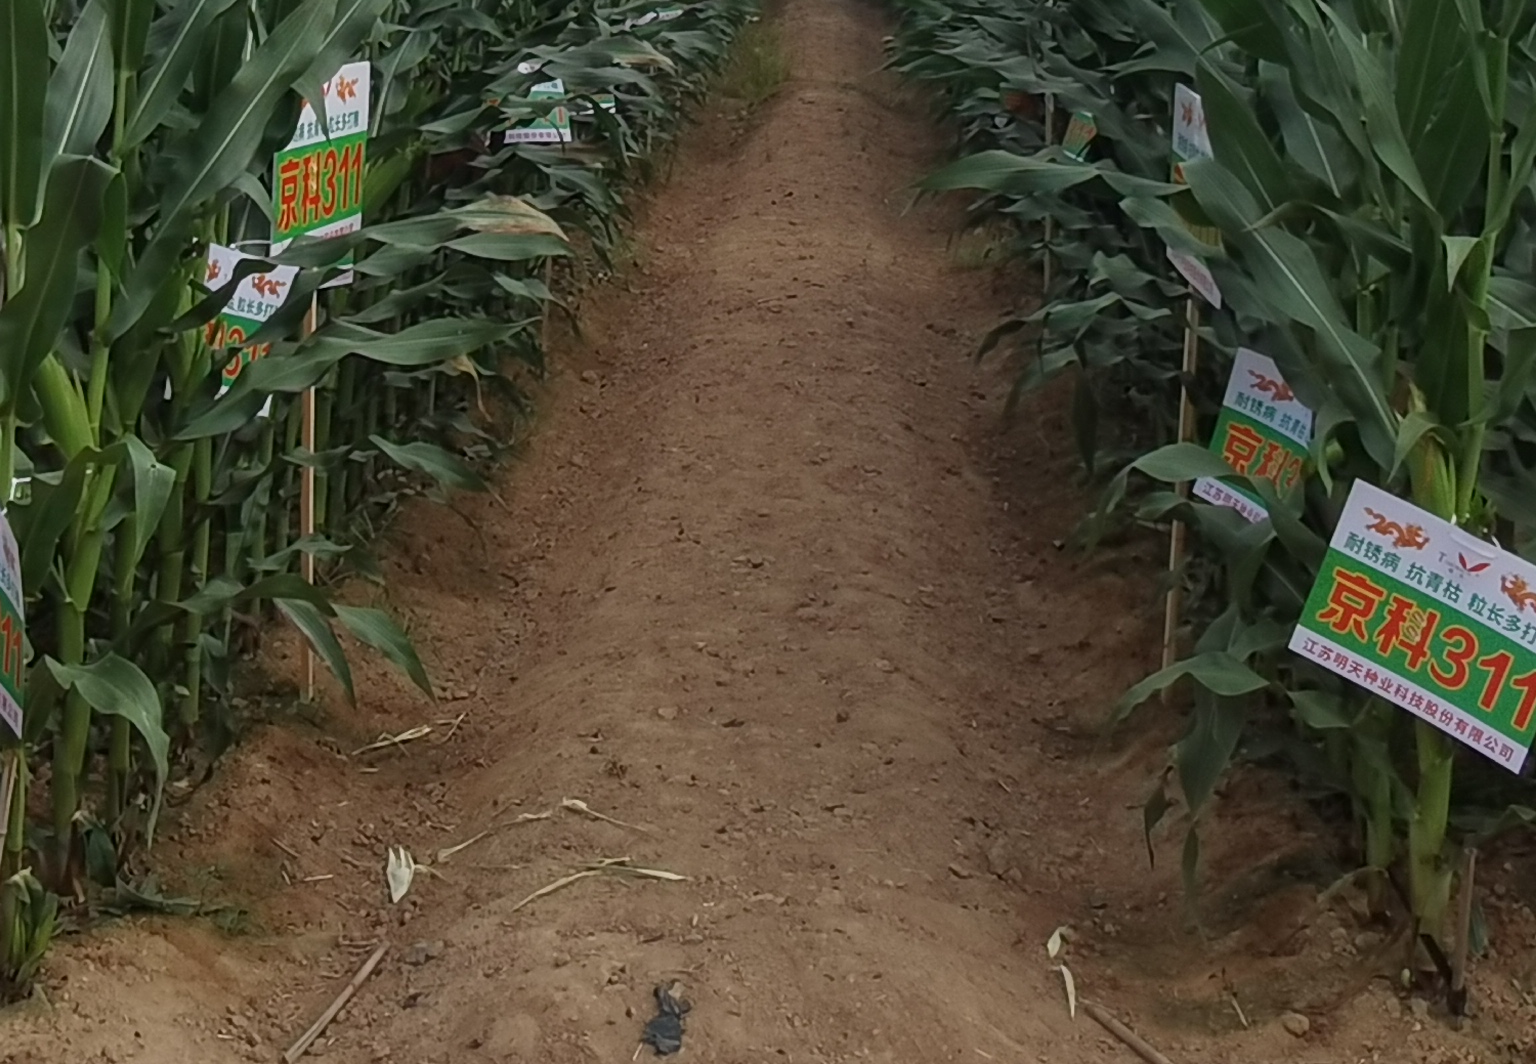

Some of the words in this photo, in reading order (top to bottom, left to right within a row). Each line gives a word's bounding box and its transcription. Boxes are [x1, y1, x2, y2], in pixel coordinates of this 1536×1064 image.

[276, 142, 363, 233] 京科311
[238, 296, 277, 317] 粒长多打
[1343, 531, 1401, 573] 耐锈病
[1405, 563, 1462, 604] 抗青枯
[1302, 637, 1515, 763] 江苏明天种业科技股份有限公司
